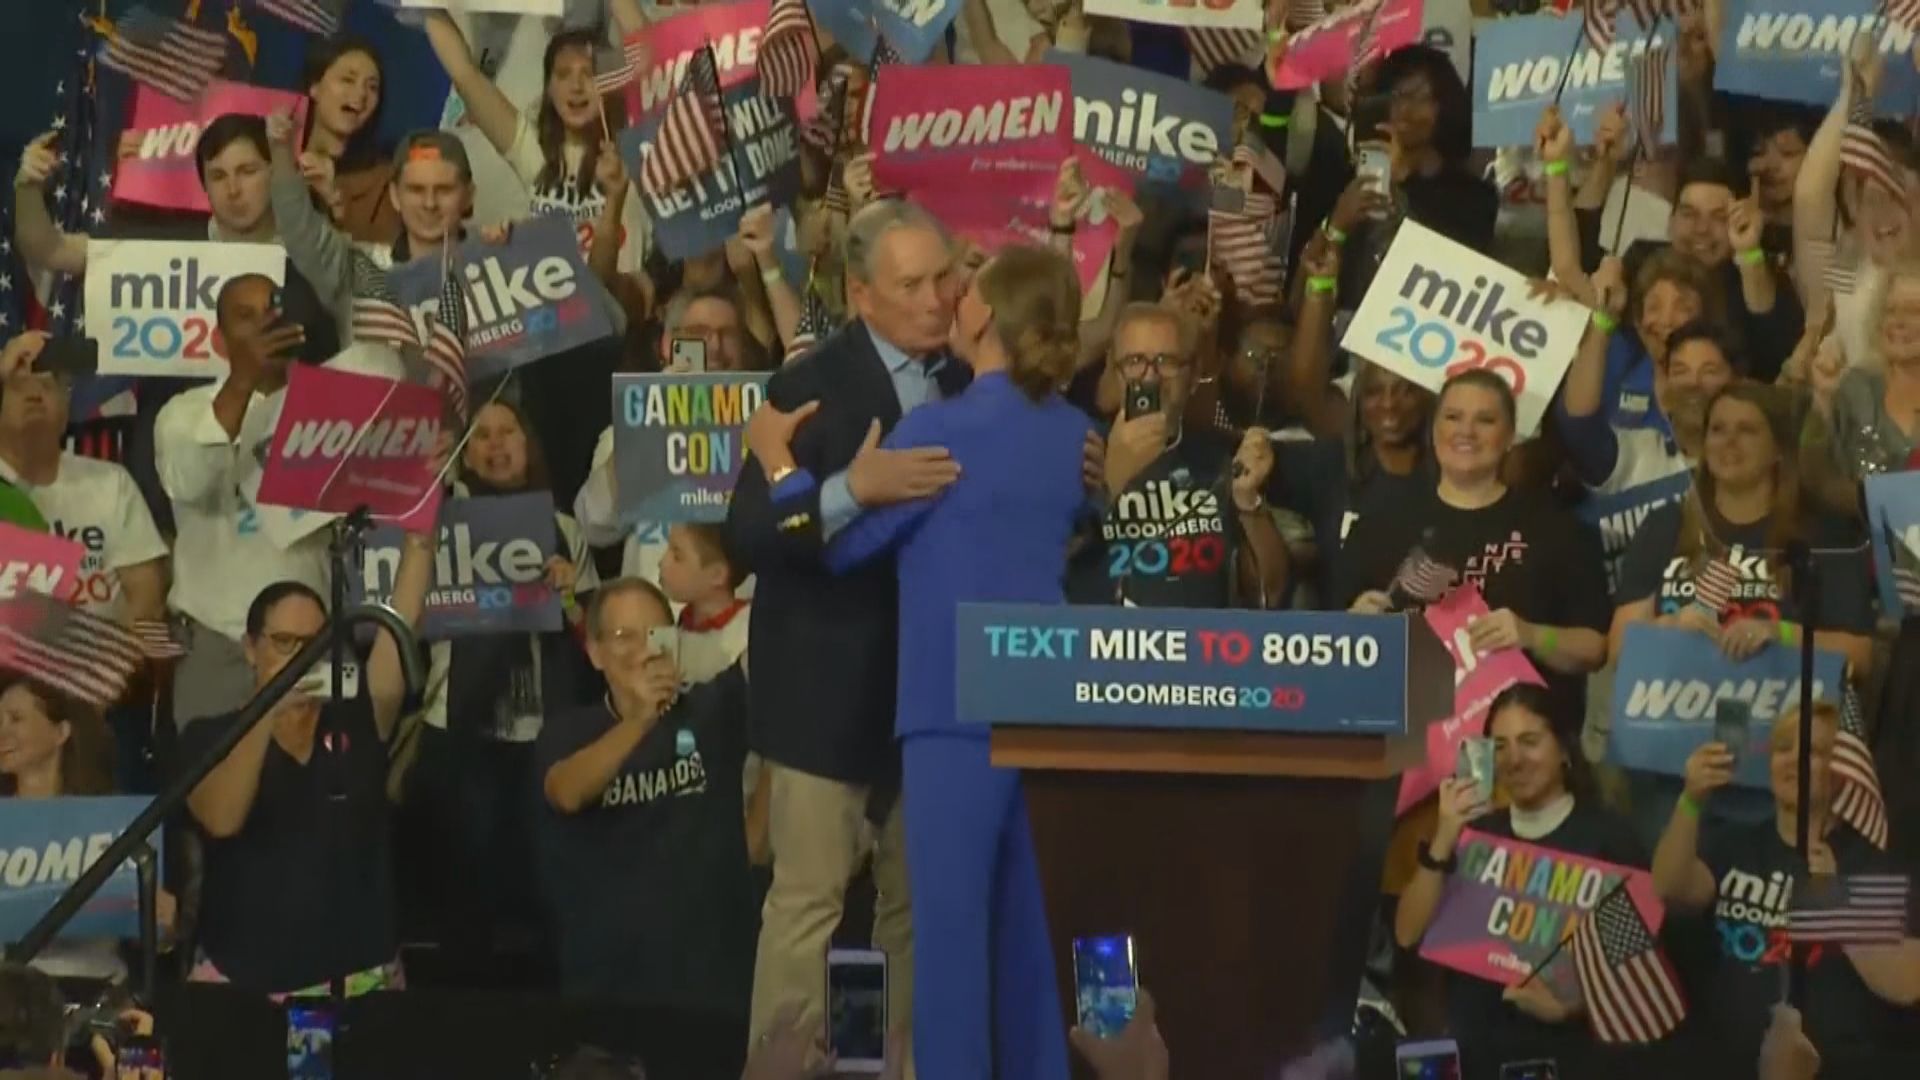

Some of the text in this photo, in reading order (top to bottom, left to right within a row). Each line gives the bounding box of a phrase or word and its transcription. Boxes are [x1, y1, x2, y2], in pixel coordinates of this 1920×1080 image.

[883, 91, 1063, 153] WOMEN
[111, 257, 223, 310] mik
[1398, 262, 1548, 360] mike
[623, 382, 770, 428] GANAMO
[281, 417, 442, 459] WOMEN
[666, 430, 731, 476] CON
[1108, 533, 1224, 578] 2020
[983, 625, 1379, 668] TEXT MIKE TO 80510
[1487, 895, 1559, 946] CON
